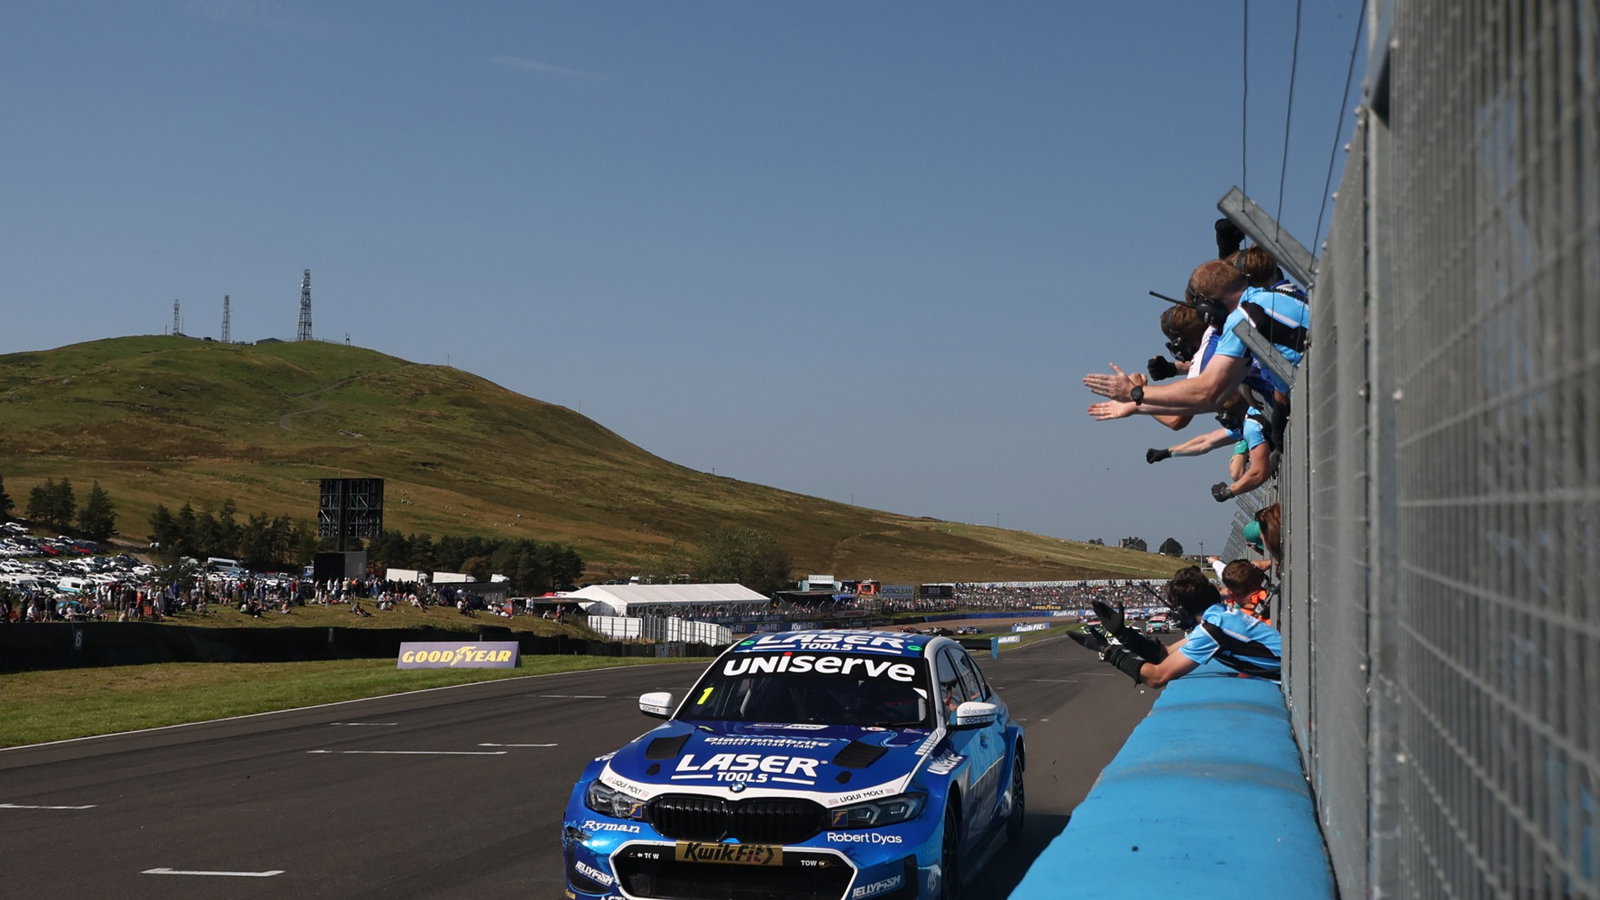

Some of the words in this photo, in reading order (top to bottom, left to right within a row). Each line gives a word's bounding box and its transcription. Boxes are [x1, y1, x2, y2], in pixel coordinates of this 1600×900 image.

[757, 633, 905, 649] LASER
[800, 642, 853, 651] TOOLS
[402, 648, 512, 663] GOODYEAR
[696, 687, 714, 705] 1
[675, 753, 819, 777] LASER
[717, 771, 768, 783] TOOLS
[611, 779, 627, 789] LIQUI
[627, 782, 643, 795] MOLY
[839, 793, 862, 803] LIQUI
[863, 789, 885, 798] MOLY
[582, 820, 640, 834] Ryman
[827, 832, 870, 843] Robert
[871, 832, 903, 846] Dyas
[800, 859, 817, 867] TOW
